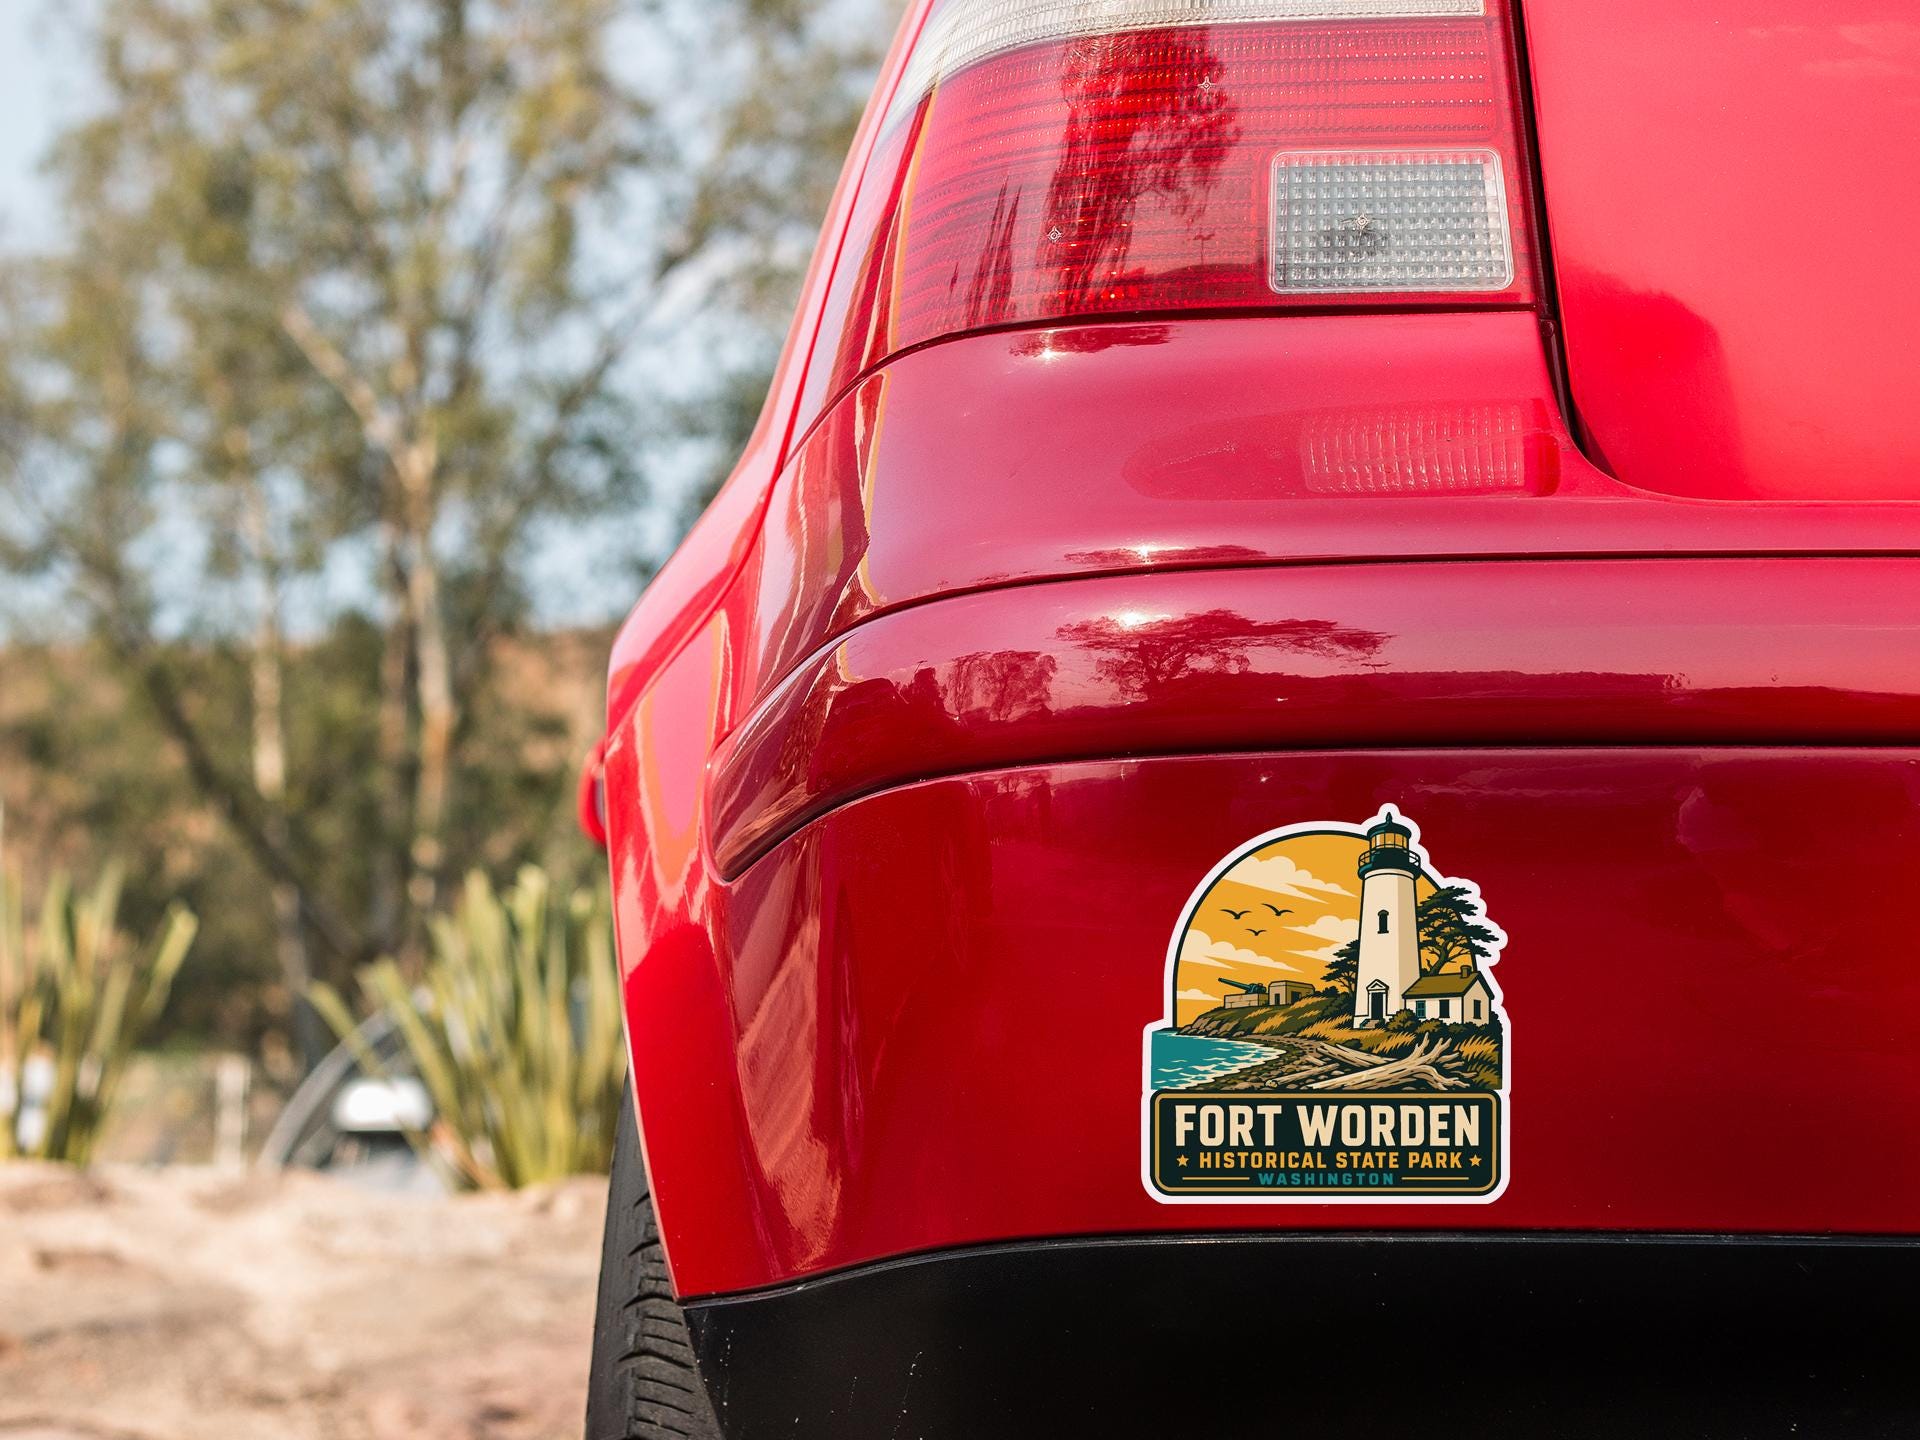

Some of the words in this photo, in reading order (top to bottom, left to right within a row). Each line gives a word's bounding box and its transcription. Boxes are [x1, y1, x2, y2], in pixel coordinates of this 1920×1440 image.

[1174, 1105, 1282, 1147] FORT
[1296, 1105, 1480, 1147] WORDEN
[1199, 1151, 1327, 1169] HISTORICAL
[1336, 1151, 1400, 1169] STATE
[1408, 1151, 1463, 1169] PARK
[1258, 1172, 1394, 1186] WASHINGTON
